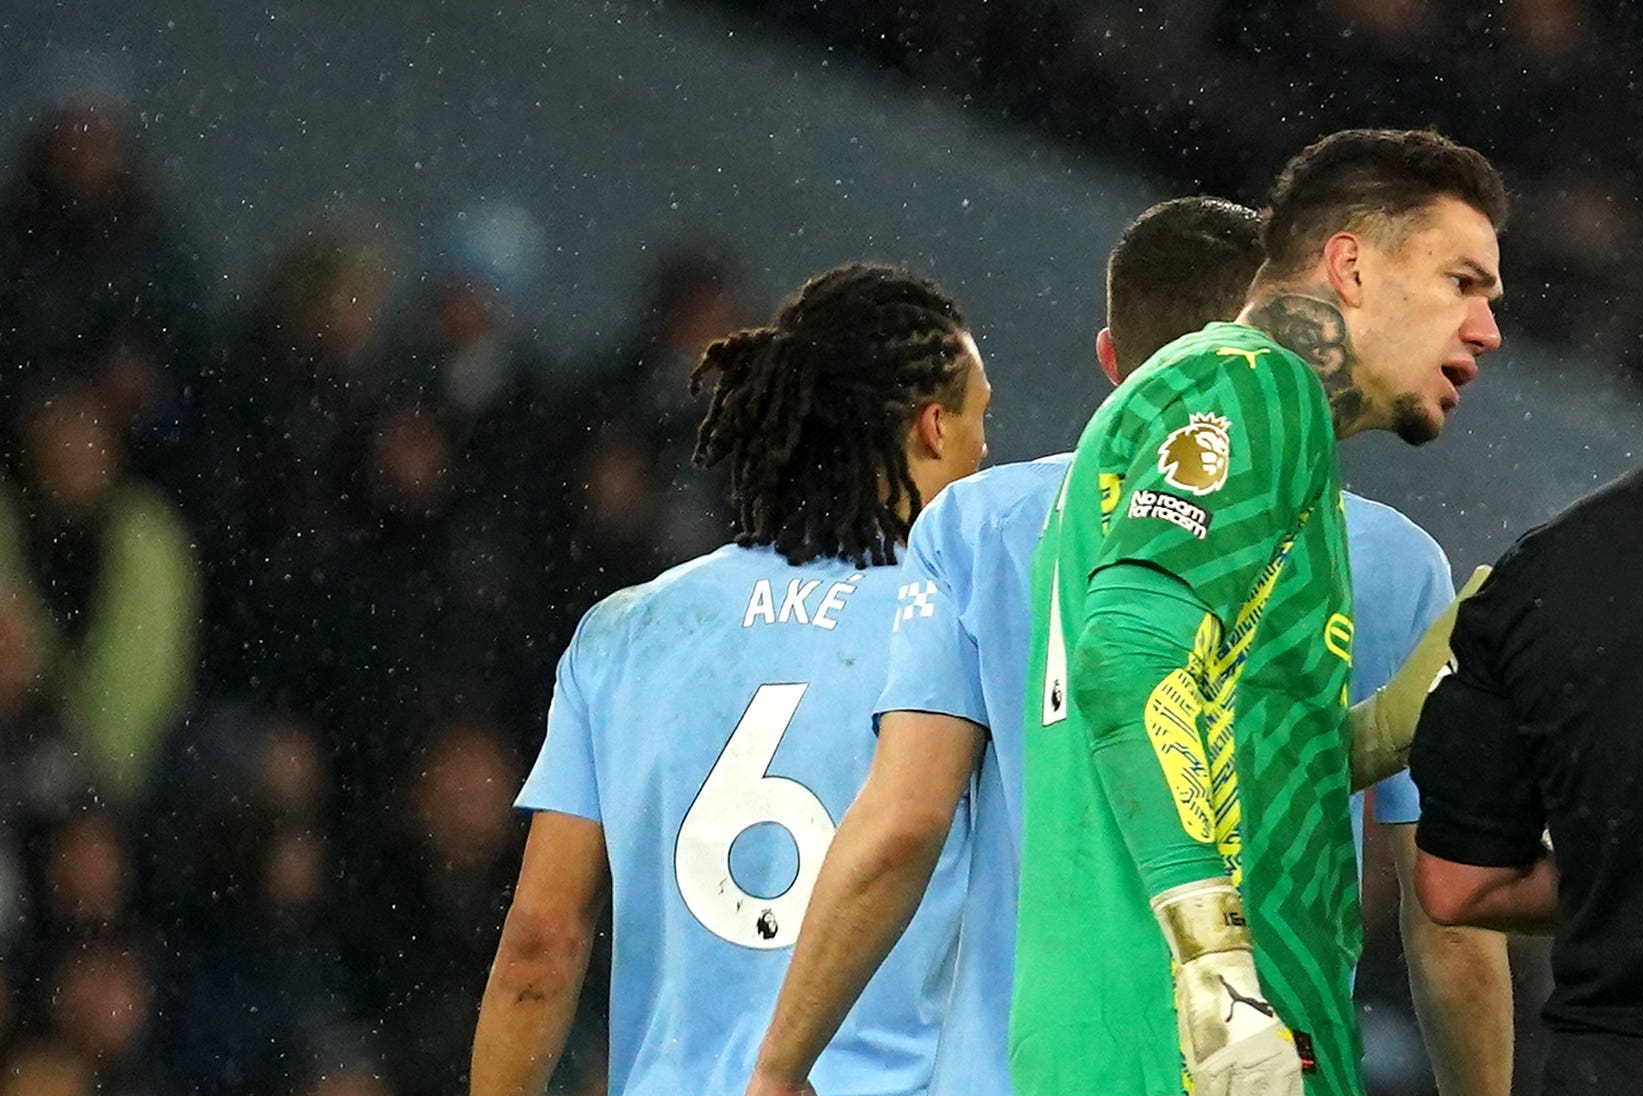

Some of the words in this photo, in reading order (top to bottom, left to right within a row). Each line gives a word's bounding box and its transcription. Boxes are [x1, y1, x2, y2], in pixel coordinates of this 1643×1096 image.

[1130, 490, 1157, 507] No
[1156, 494, 1206, 523] room
[1150, 506, 1206, 540] racism
[742, 572, 866, 631] AKÉ
[674, 682, 838, 951] 6
